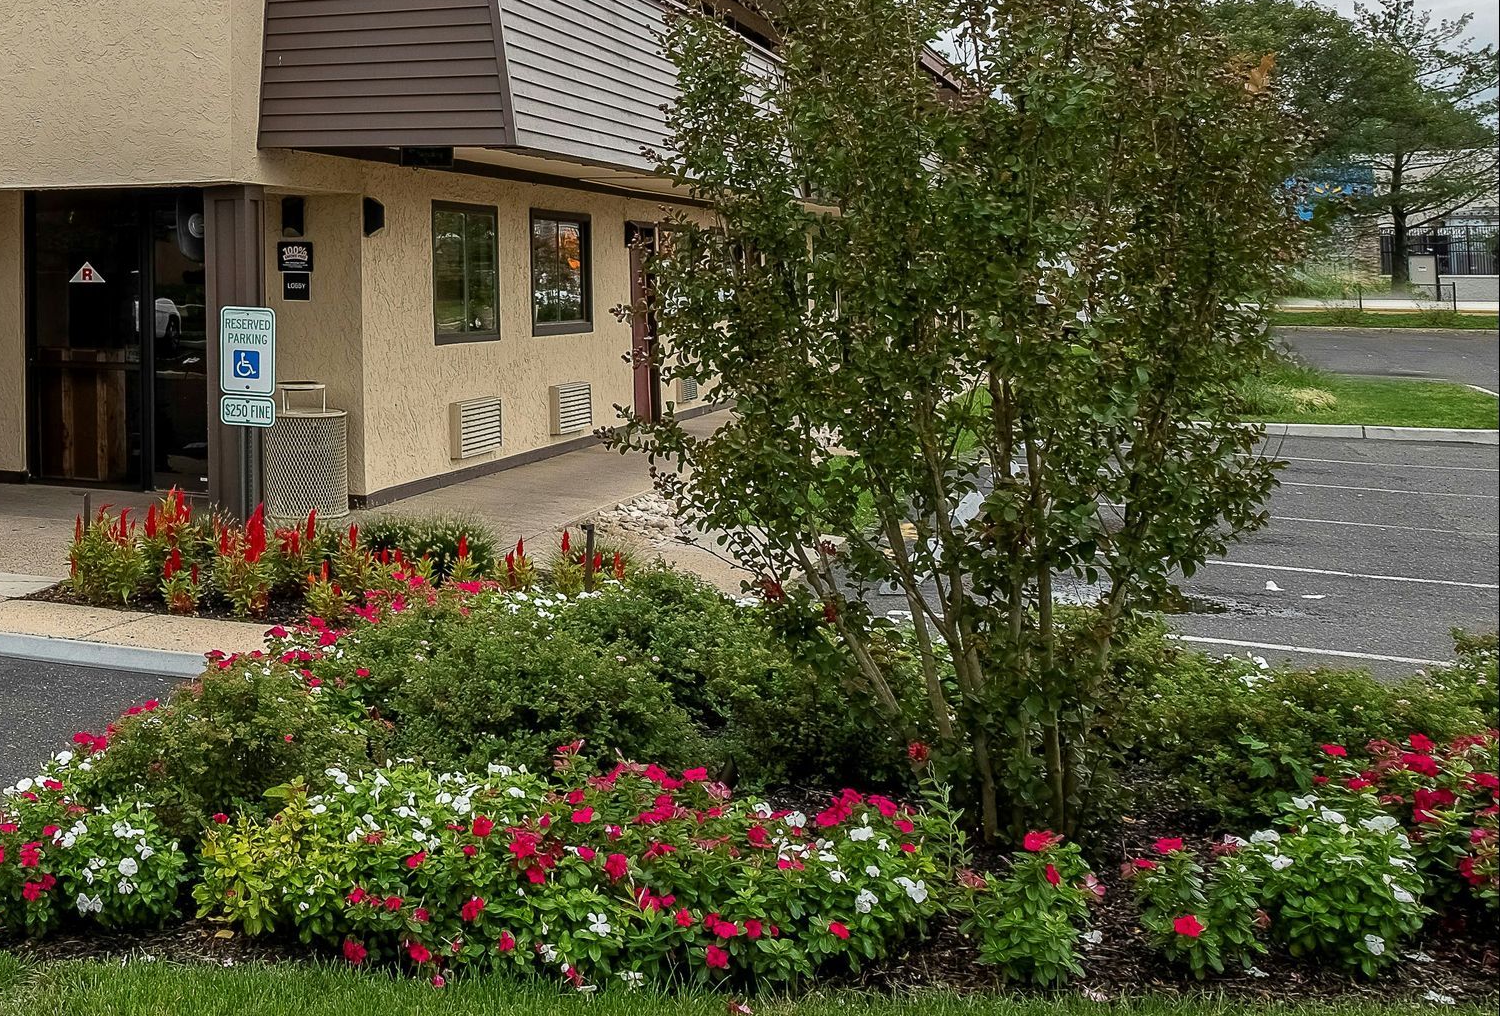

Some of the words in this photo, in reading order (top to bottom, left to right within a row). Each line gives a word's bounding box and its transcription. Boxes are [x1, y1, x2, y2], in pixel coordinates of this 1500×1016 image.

[282, 245, 308, 256] 100%
[82, 268, 93, 281] R
[225, 318, 271, 331] RESERVED
[228, 333, 268, 345] PARKING
[225, 404, 248, 418] $250
[251, 405, 271, 420] FINE
